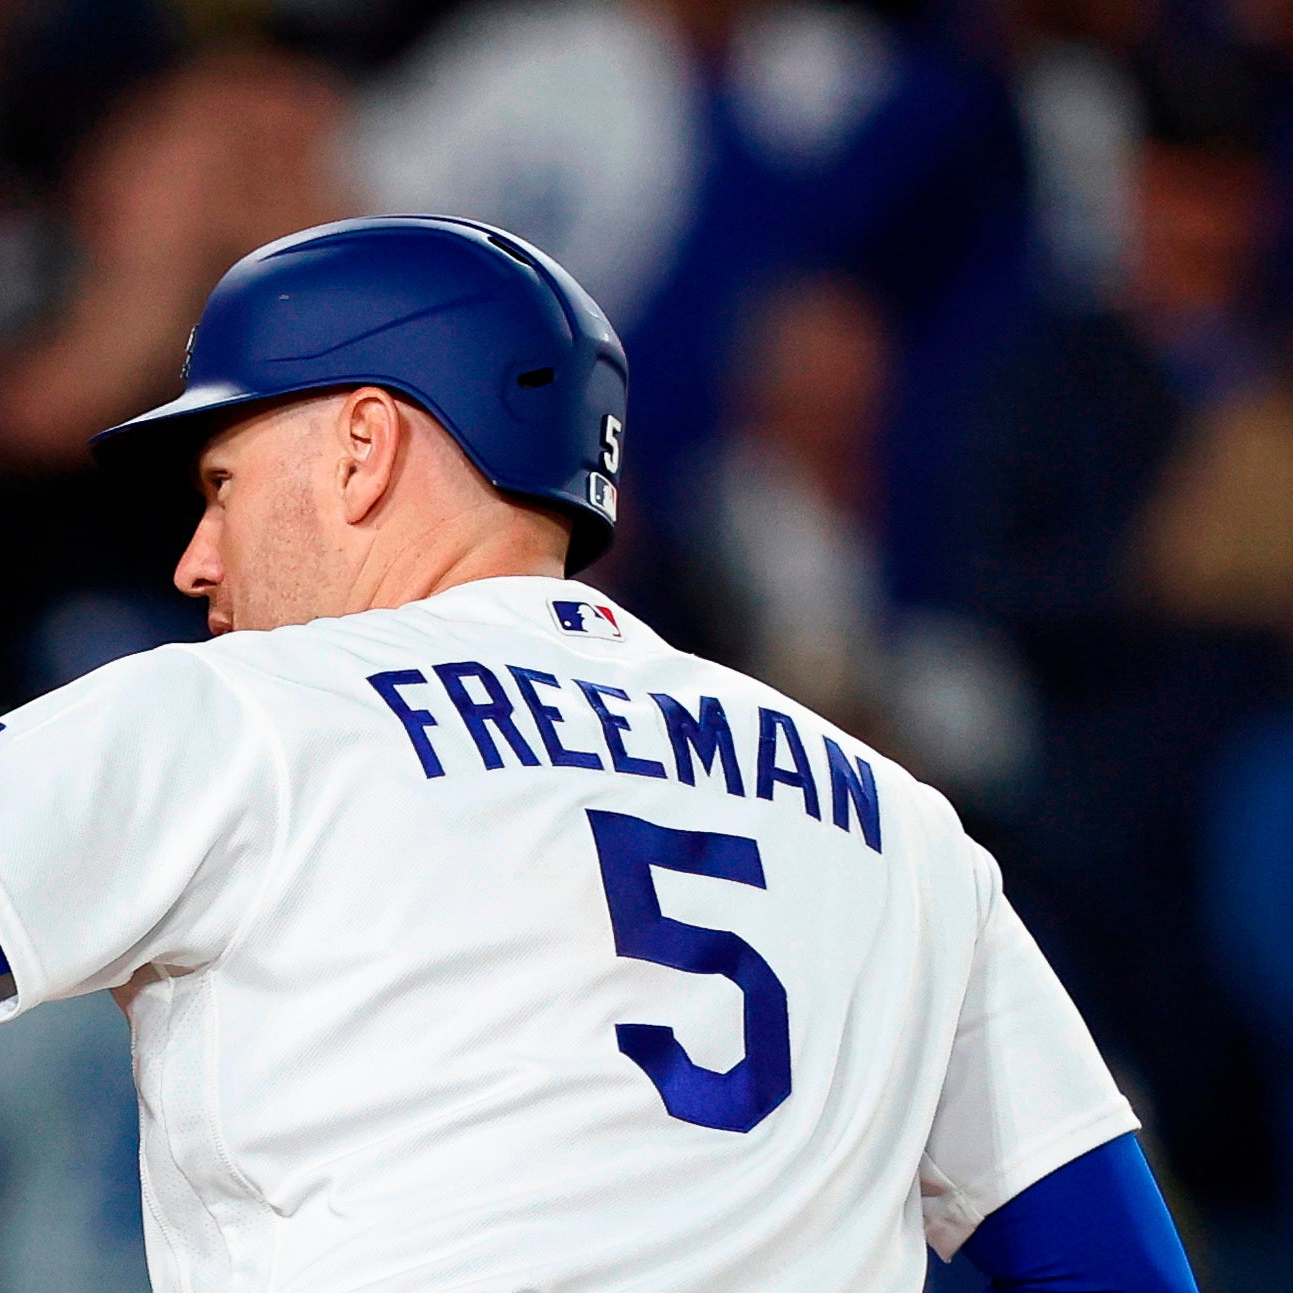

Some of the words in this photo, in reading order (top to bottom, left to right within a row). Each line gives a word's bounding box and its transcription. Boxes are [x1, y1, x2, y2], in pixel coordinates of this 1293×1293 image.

[604, 414, 623, 474] 5
[367, 660, 883, 855] FREEMAN
[585, 808, 793, 1133] 5
